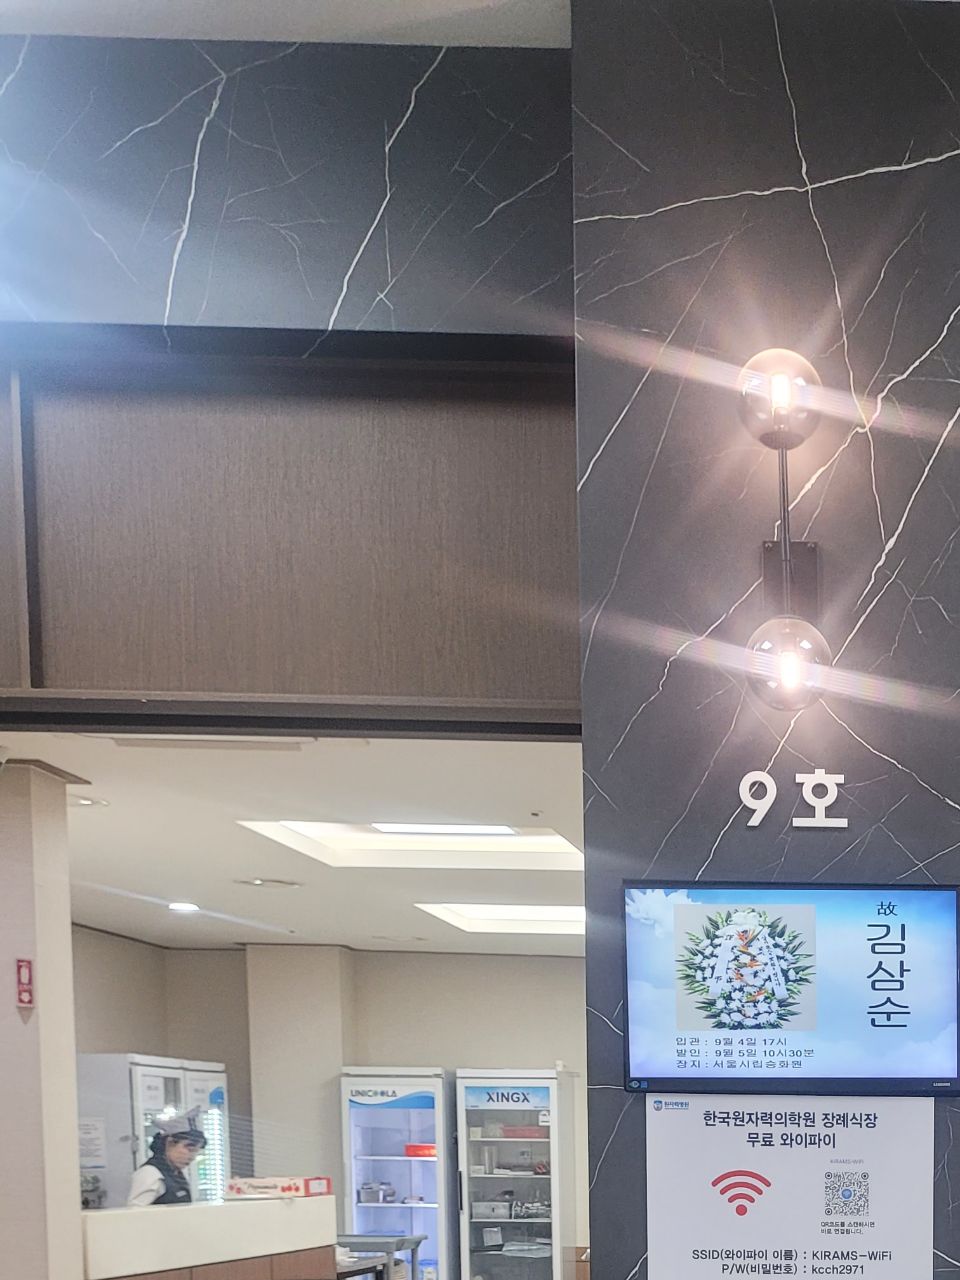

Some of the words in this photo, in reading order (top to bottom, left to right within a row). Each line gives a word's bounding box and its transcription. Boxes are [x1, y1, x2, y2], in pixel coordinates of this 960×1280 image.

[877, 901, 898, 916] 故
[866, 923, 912, 1028] 김삼순
[714, 1038, 733, 1046] 9월
[738, 1038, 757, 1046] 4일
[762, 1038, 787, 1046] 17시
[738, 1049, 757, 1058] 5일
[762, 1049, 815, 1058] 10시30분
[713, 1059, 802, 1069] 서울시립승화원
[703, 1110, 816, 1128] 한국원자력의학원
[821, 1112, 879, 1129] 장례식장
[746, 1132, 775, 1148] 무료
[779, 1132, 836, 1149] 와이파이
[692, 1248, 768, 1261] SSID(와이파이
[772, 1248, 798, 1261] 이름)
[812, 1250, 892, 1261] KIRAMS-WiFi
[721, 1263, 798, 1276] P/W(비밀번호)
[811, 1264, 864, 1275] kcch2971
